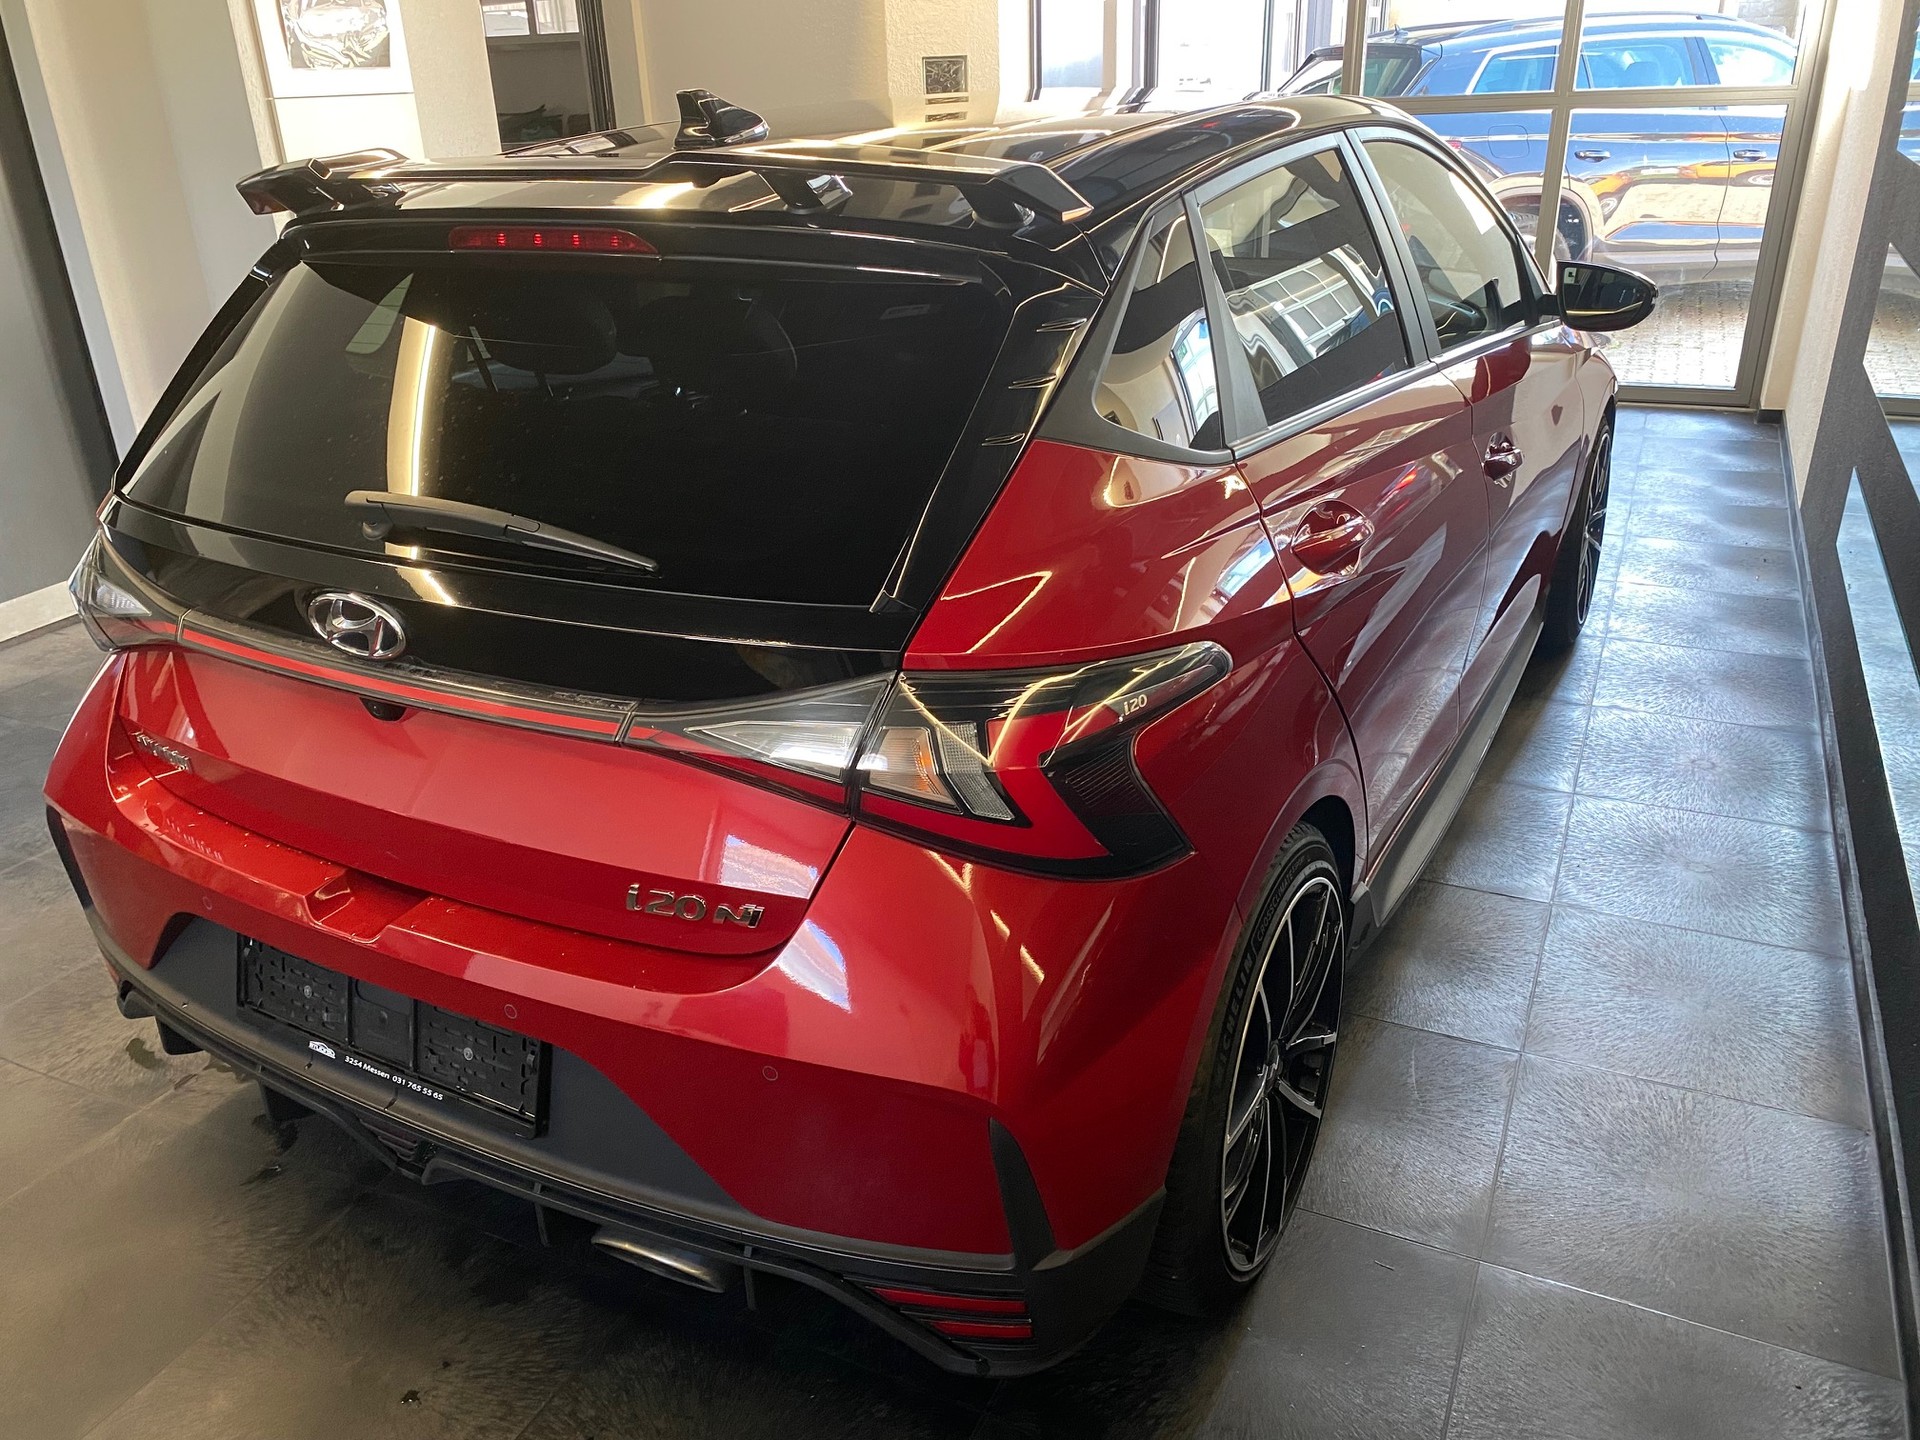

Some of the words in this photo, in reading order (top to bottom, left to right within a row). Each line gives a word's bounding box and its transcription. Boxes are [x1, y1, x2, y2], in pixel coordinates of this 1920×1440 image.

[1124, 694, 1148, 716] i20
[626, 883, 707, 921] i20
[713, 903, 766, 929] N
[344, 1055, 363, 1069] 3254
[362, 1063, 390, 1080] Messen
[391, 1075, 406, 1086] 031
[407, 1081, 422, 1093] 765
[422, 1087, 433, 1098] 55
[432, 1091, 444, 1101] 65
